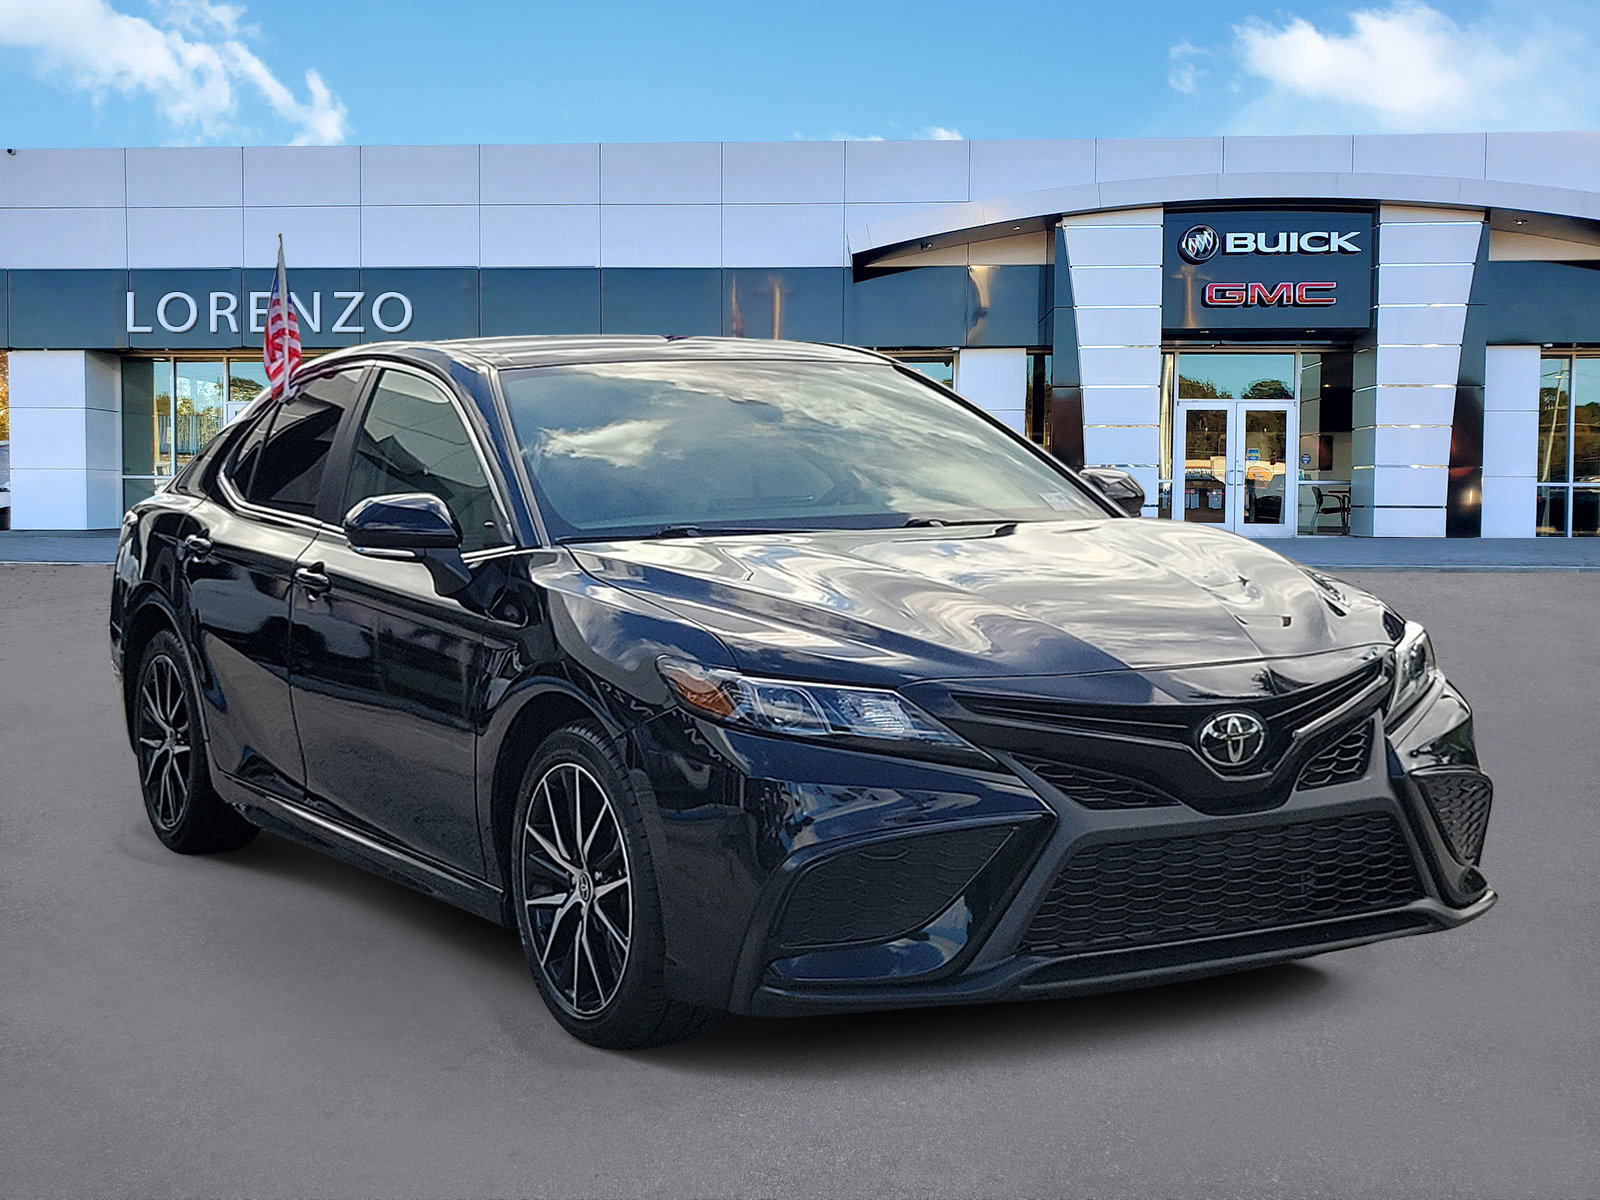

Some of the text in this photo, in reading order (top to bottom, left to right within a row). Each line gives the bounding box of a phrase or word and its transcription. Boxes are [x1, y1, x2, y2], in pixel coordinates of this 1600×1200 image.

[1225, 231, 1362, 253] BUICK
[1204, 281, 1337, 306] GMC
[125, 290, 414, 334] LORENZO
